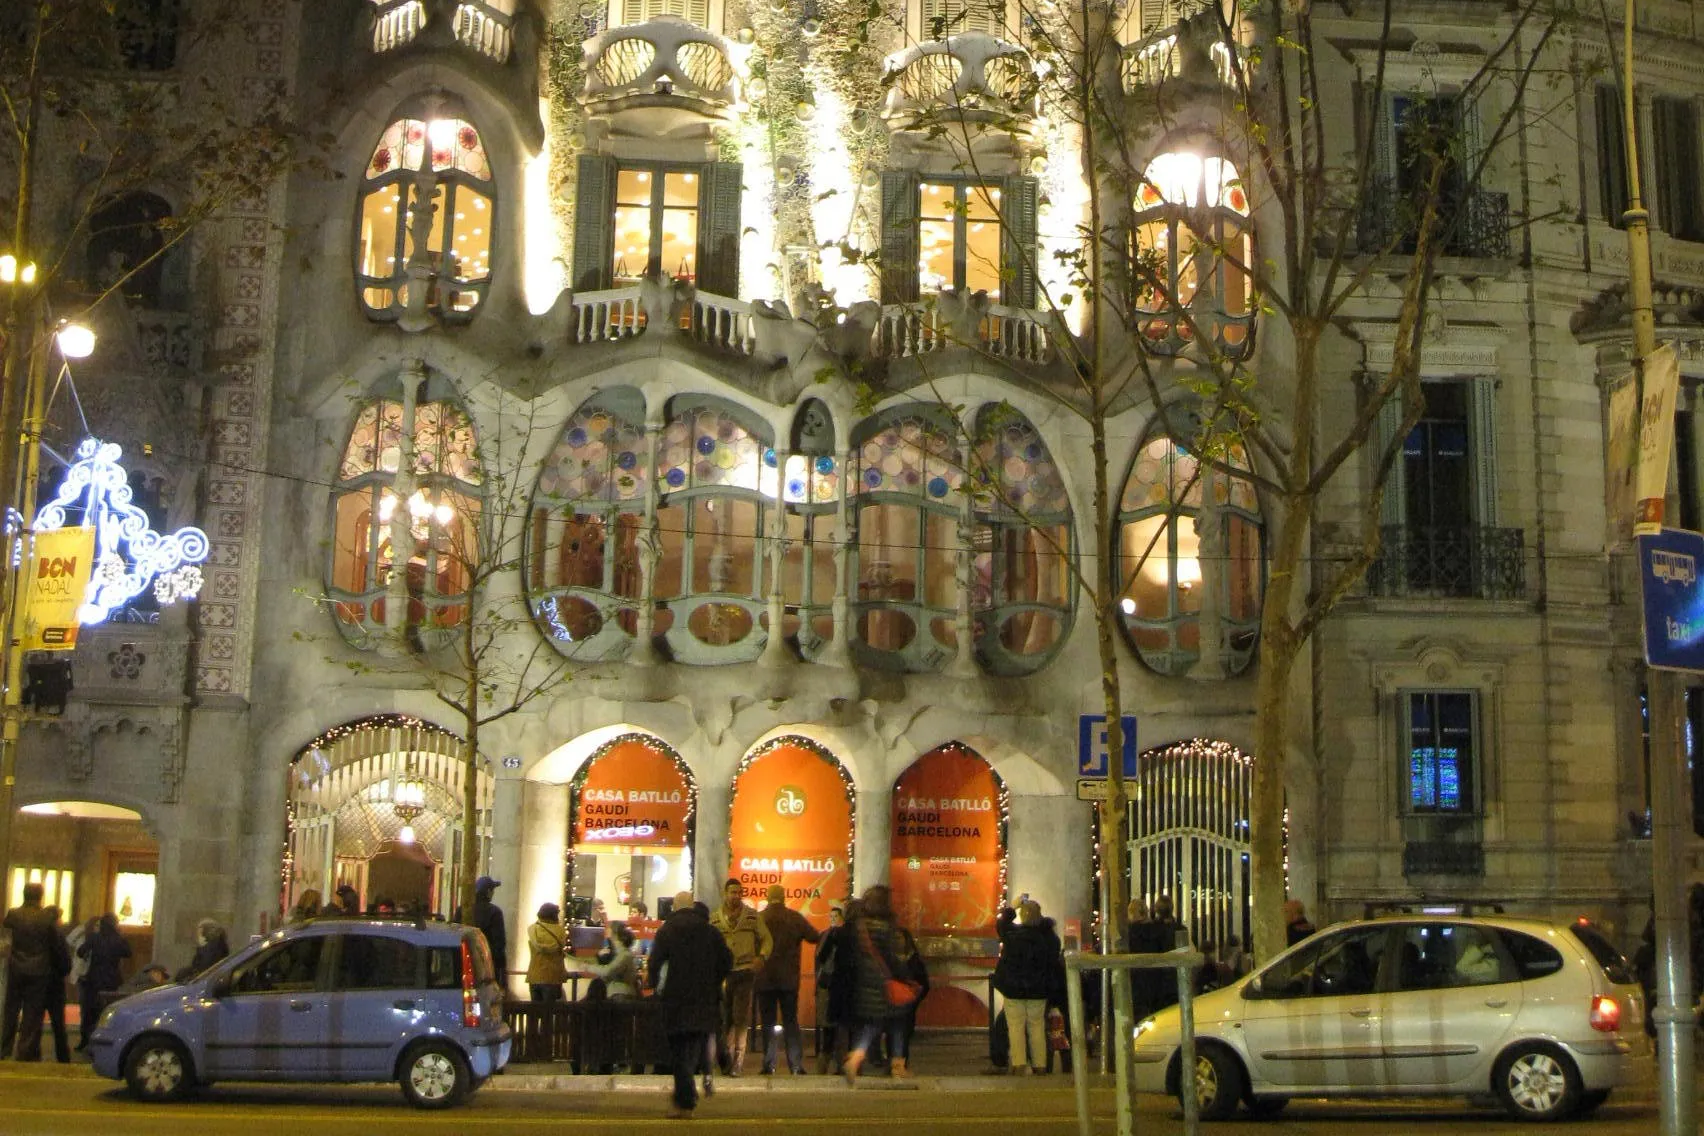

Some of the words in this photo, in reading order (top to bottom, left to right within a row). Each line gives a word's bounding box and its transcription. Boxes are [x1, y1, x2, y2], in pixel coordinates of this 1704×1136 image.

[38, 556, 77, 579] BCN
[1666, 615, 1690, 641] taxi
[584, 789, 624, 802] CASA
[628, 789, 681, 803] BATLLÓ
[898, 797, 936, 810] CASA
[941, 797, 992, 811] BATLLÓ
[584, 818, 670, 831] BARCELONA
[896, 826, 981, 838] BARCELONA
[740, 858, 779, 871] CASA
[783, 857, 835, 872] BATLLÓ
[739, 886, 821, 899] BARLONA
